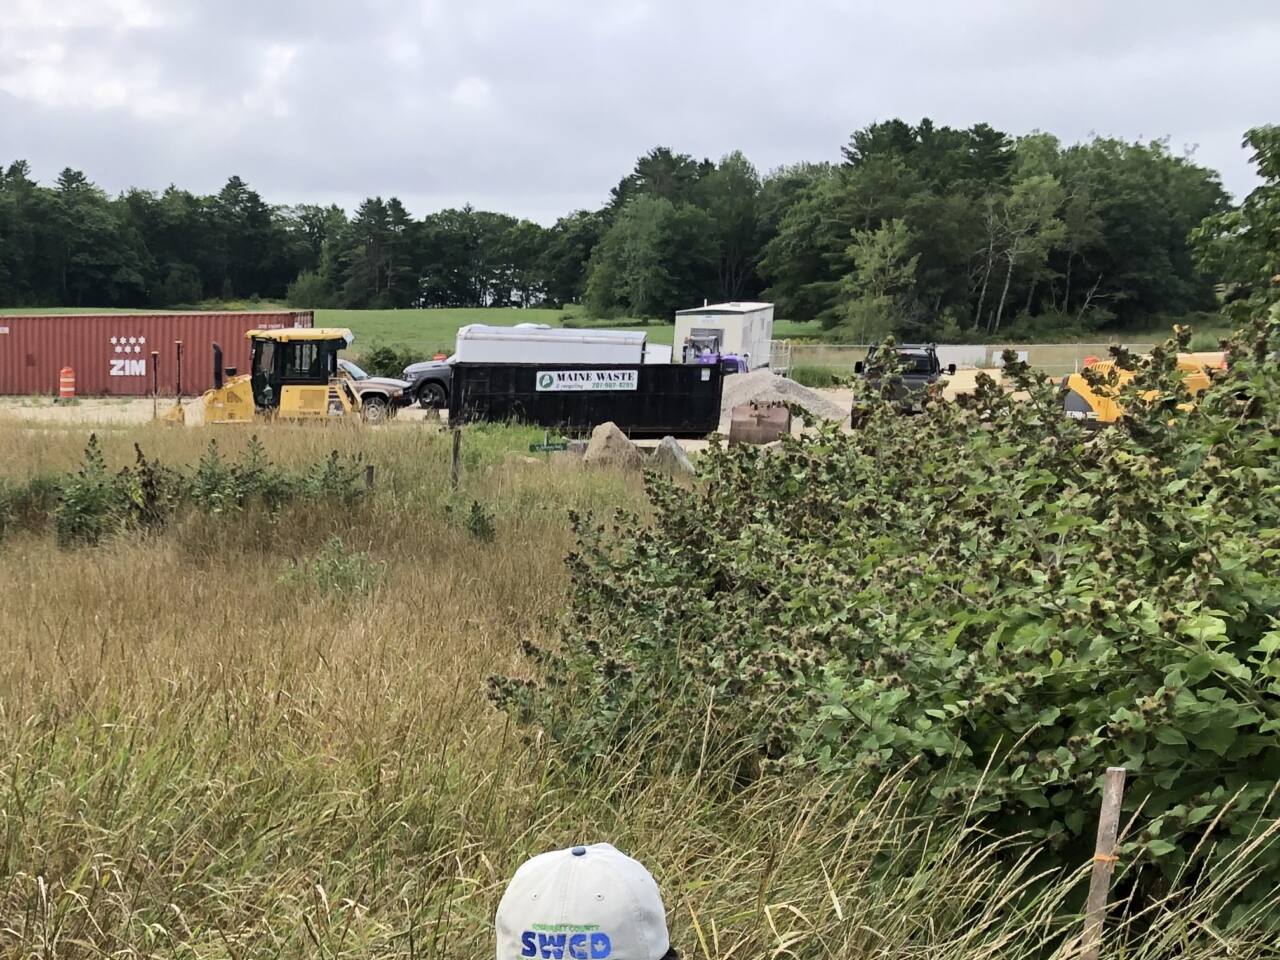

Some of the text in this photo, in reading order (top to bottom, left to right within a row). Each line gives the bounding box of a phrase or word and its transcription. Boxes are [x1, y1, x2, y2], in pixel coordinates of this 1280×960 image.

[110, 360, 145, 376] ZIM
[557, 371, 635, 382] MAINE WASTE
[521, 931, 612, 960] SWCD
